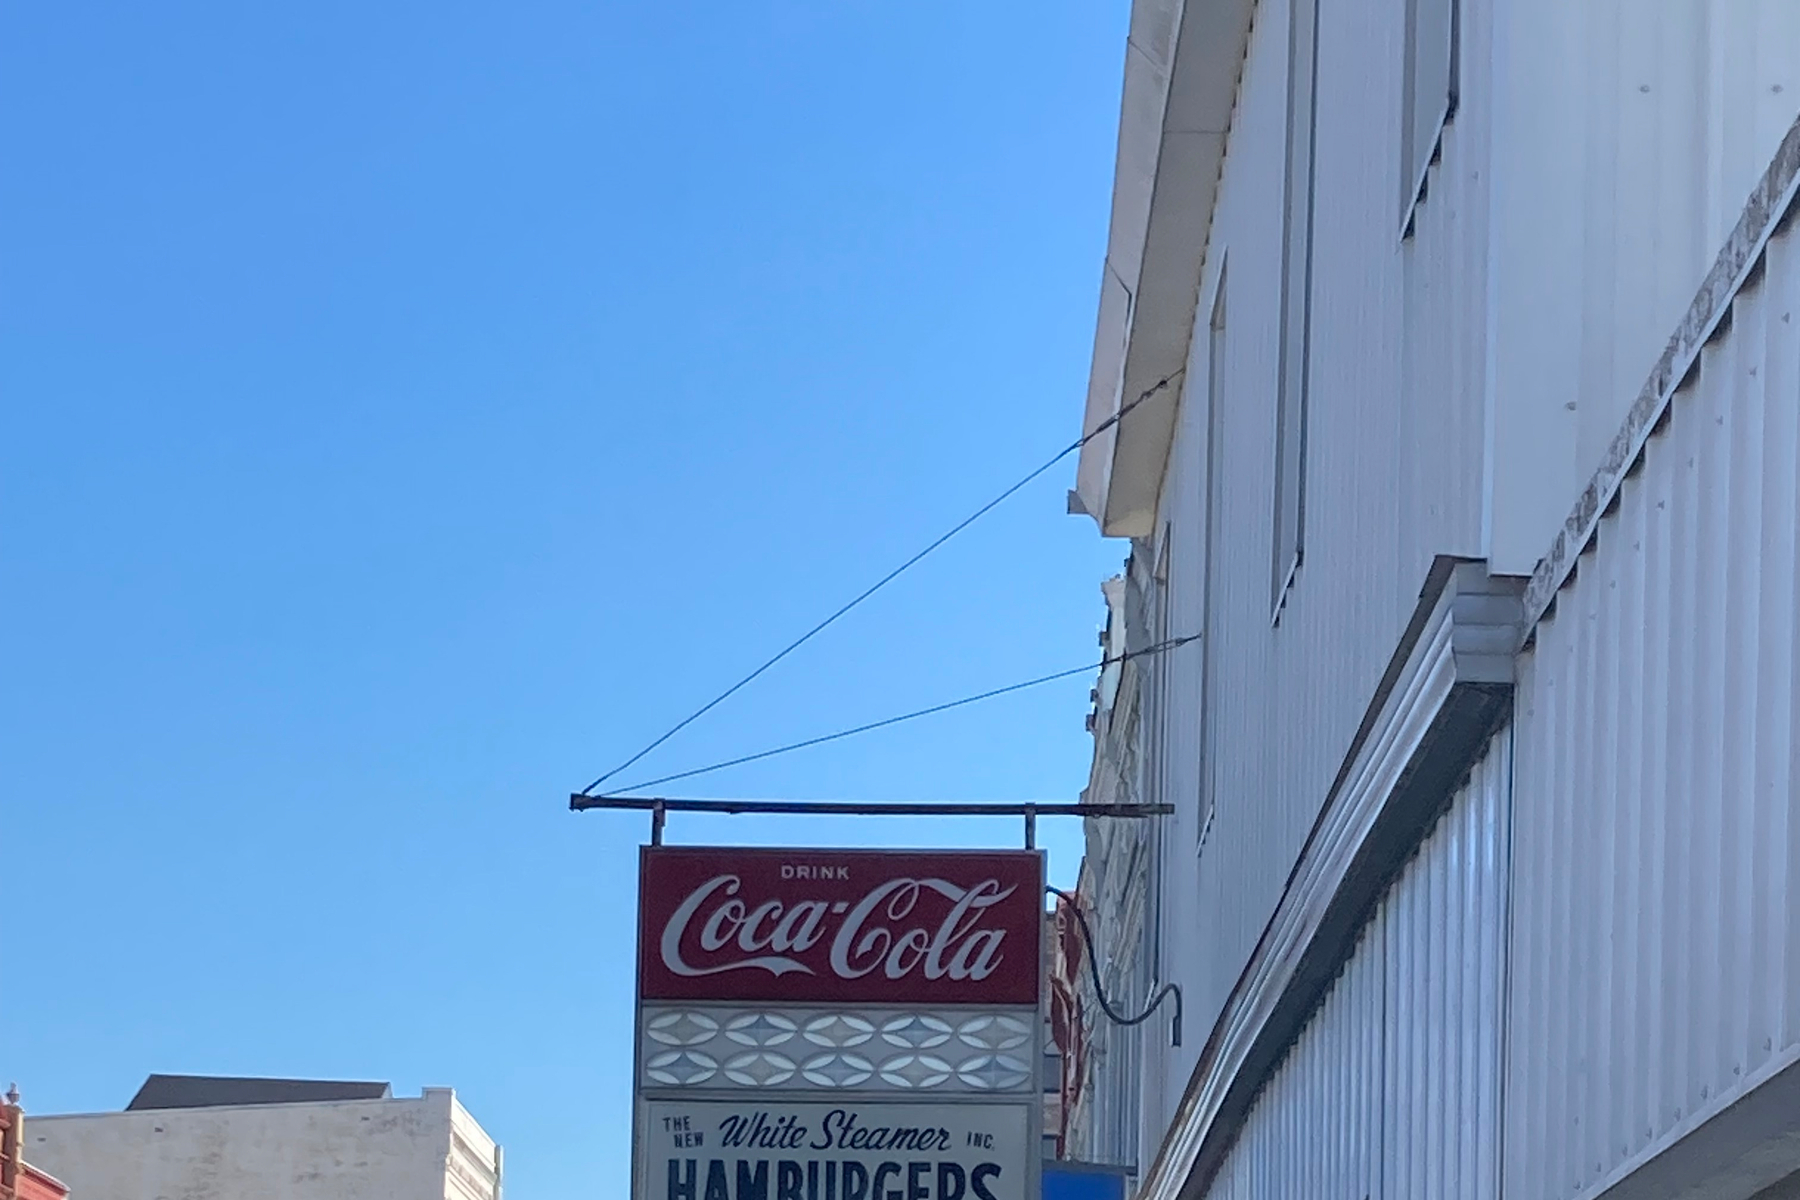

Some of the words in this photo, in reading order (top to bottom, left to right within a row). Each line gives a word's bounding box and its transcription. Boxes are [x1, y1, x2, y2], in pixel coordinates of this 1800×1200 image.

[781, 865, 850, 880] DRINK
[660, 875, 1018, 981] Coca-Cola
[663, 1116, 690, 1132] THE
[719, 1111, 806, 1150] White
[809, 1109, 951, 1151] Steamer
[674, 1132, 704, 1148] NEW
